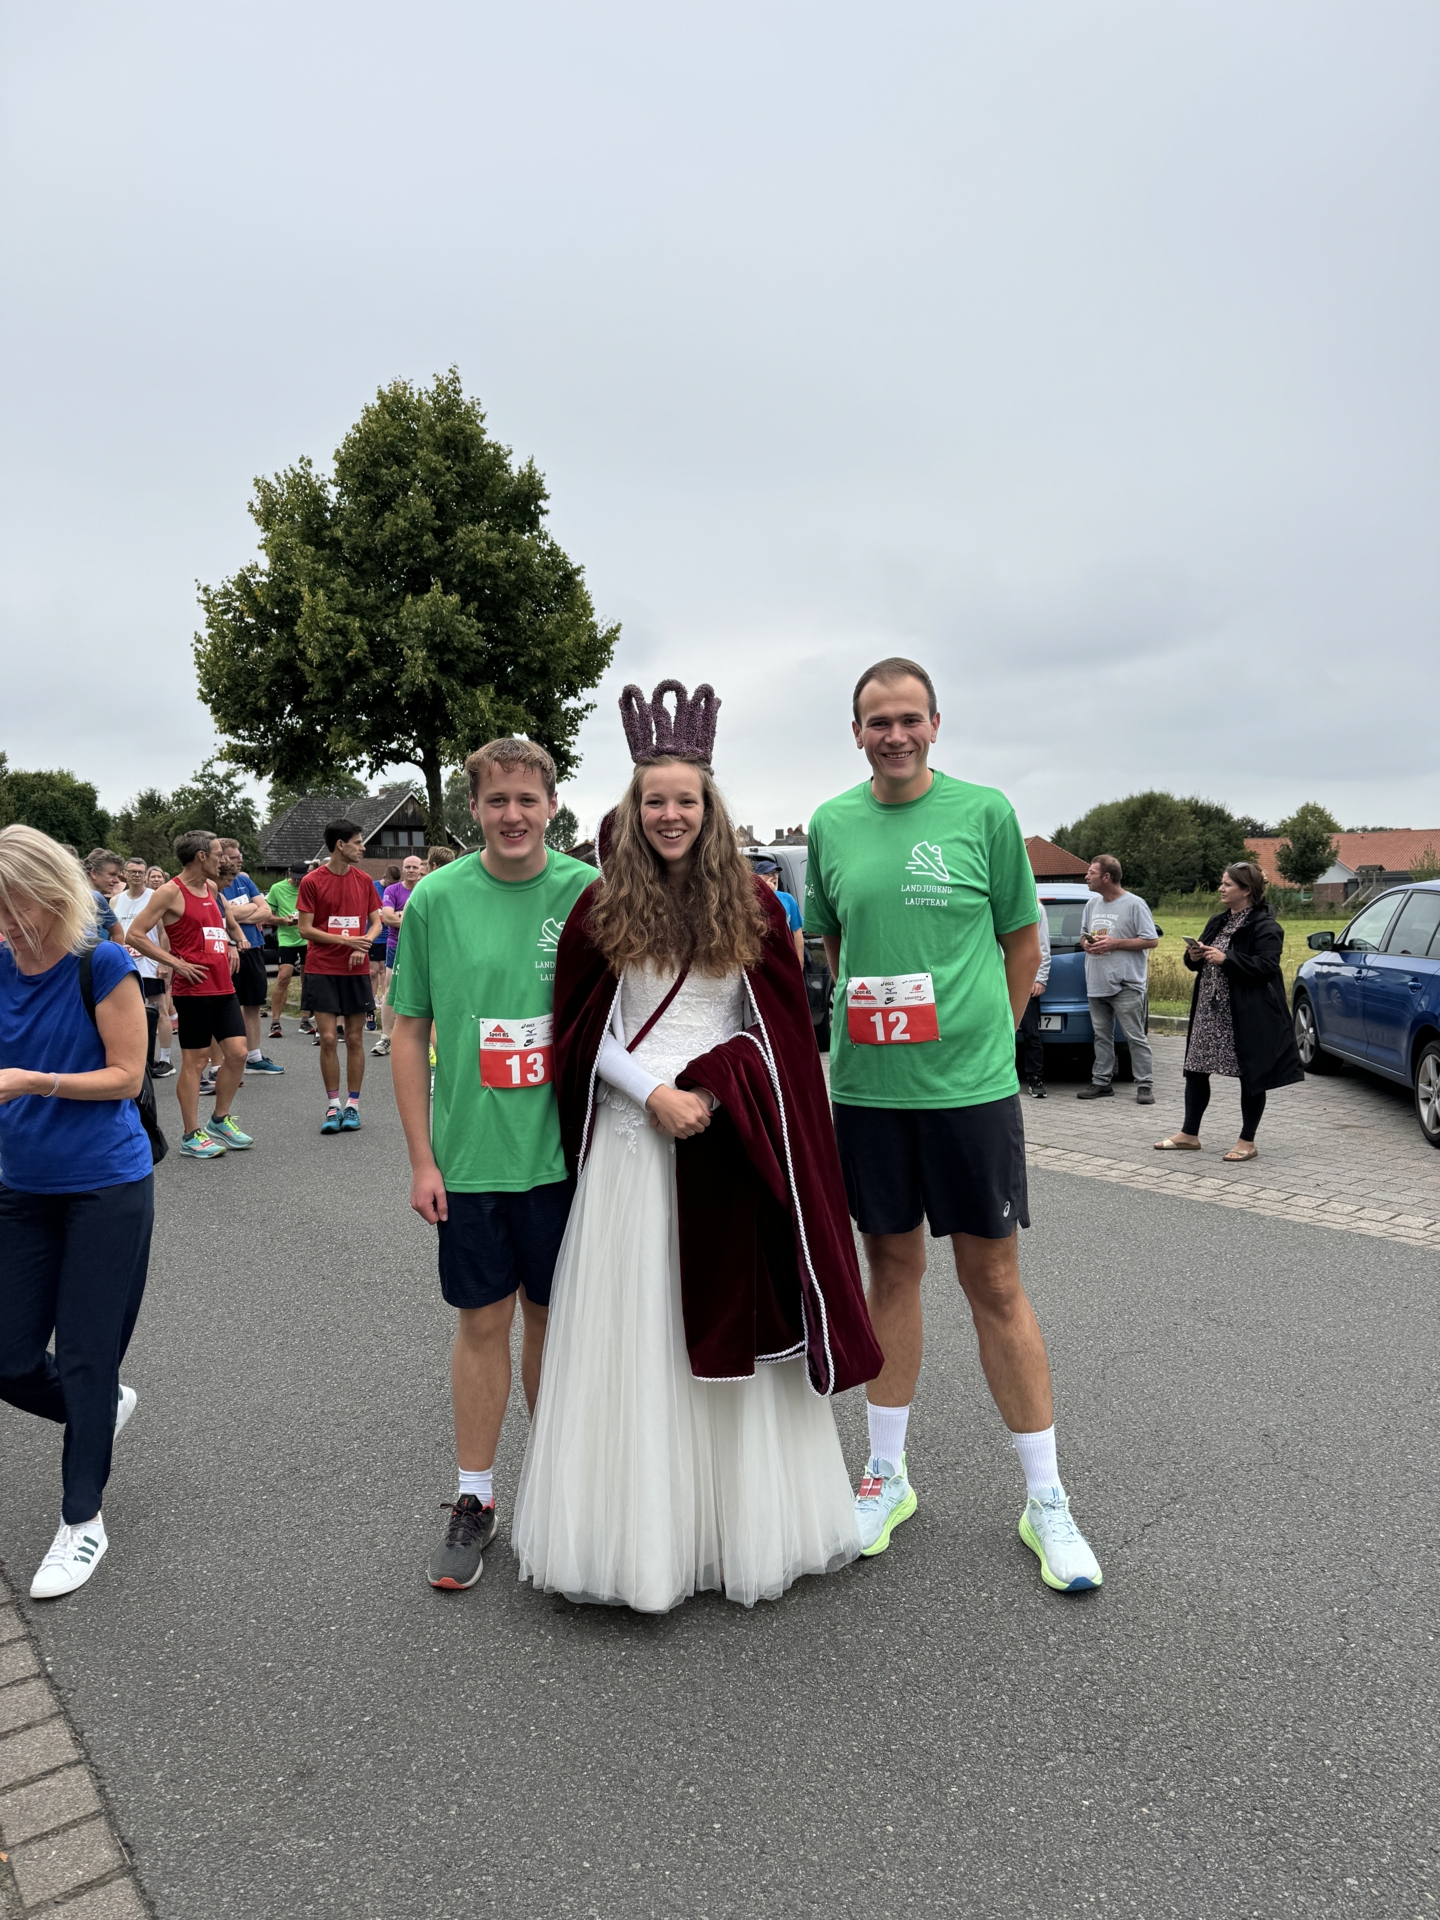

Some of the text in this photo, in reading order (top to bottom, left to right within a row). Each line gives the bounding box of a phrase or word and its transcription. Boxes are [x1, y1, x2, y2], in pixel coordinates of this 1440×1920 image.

[901, 884, 953, 894] LANDJUGEND
[905, 897, 948, 907] LAUFTEAM
[341, 929, 350, 937] 6
[213, 940, 226, 953] 49
[535, 960, 556, 969] LAND
[540, 973, 555, 981] LAU
[869, 1010, 911, 1041] 12
[505, 1052, 545, 1085] 13
